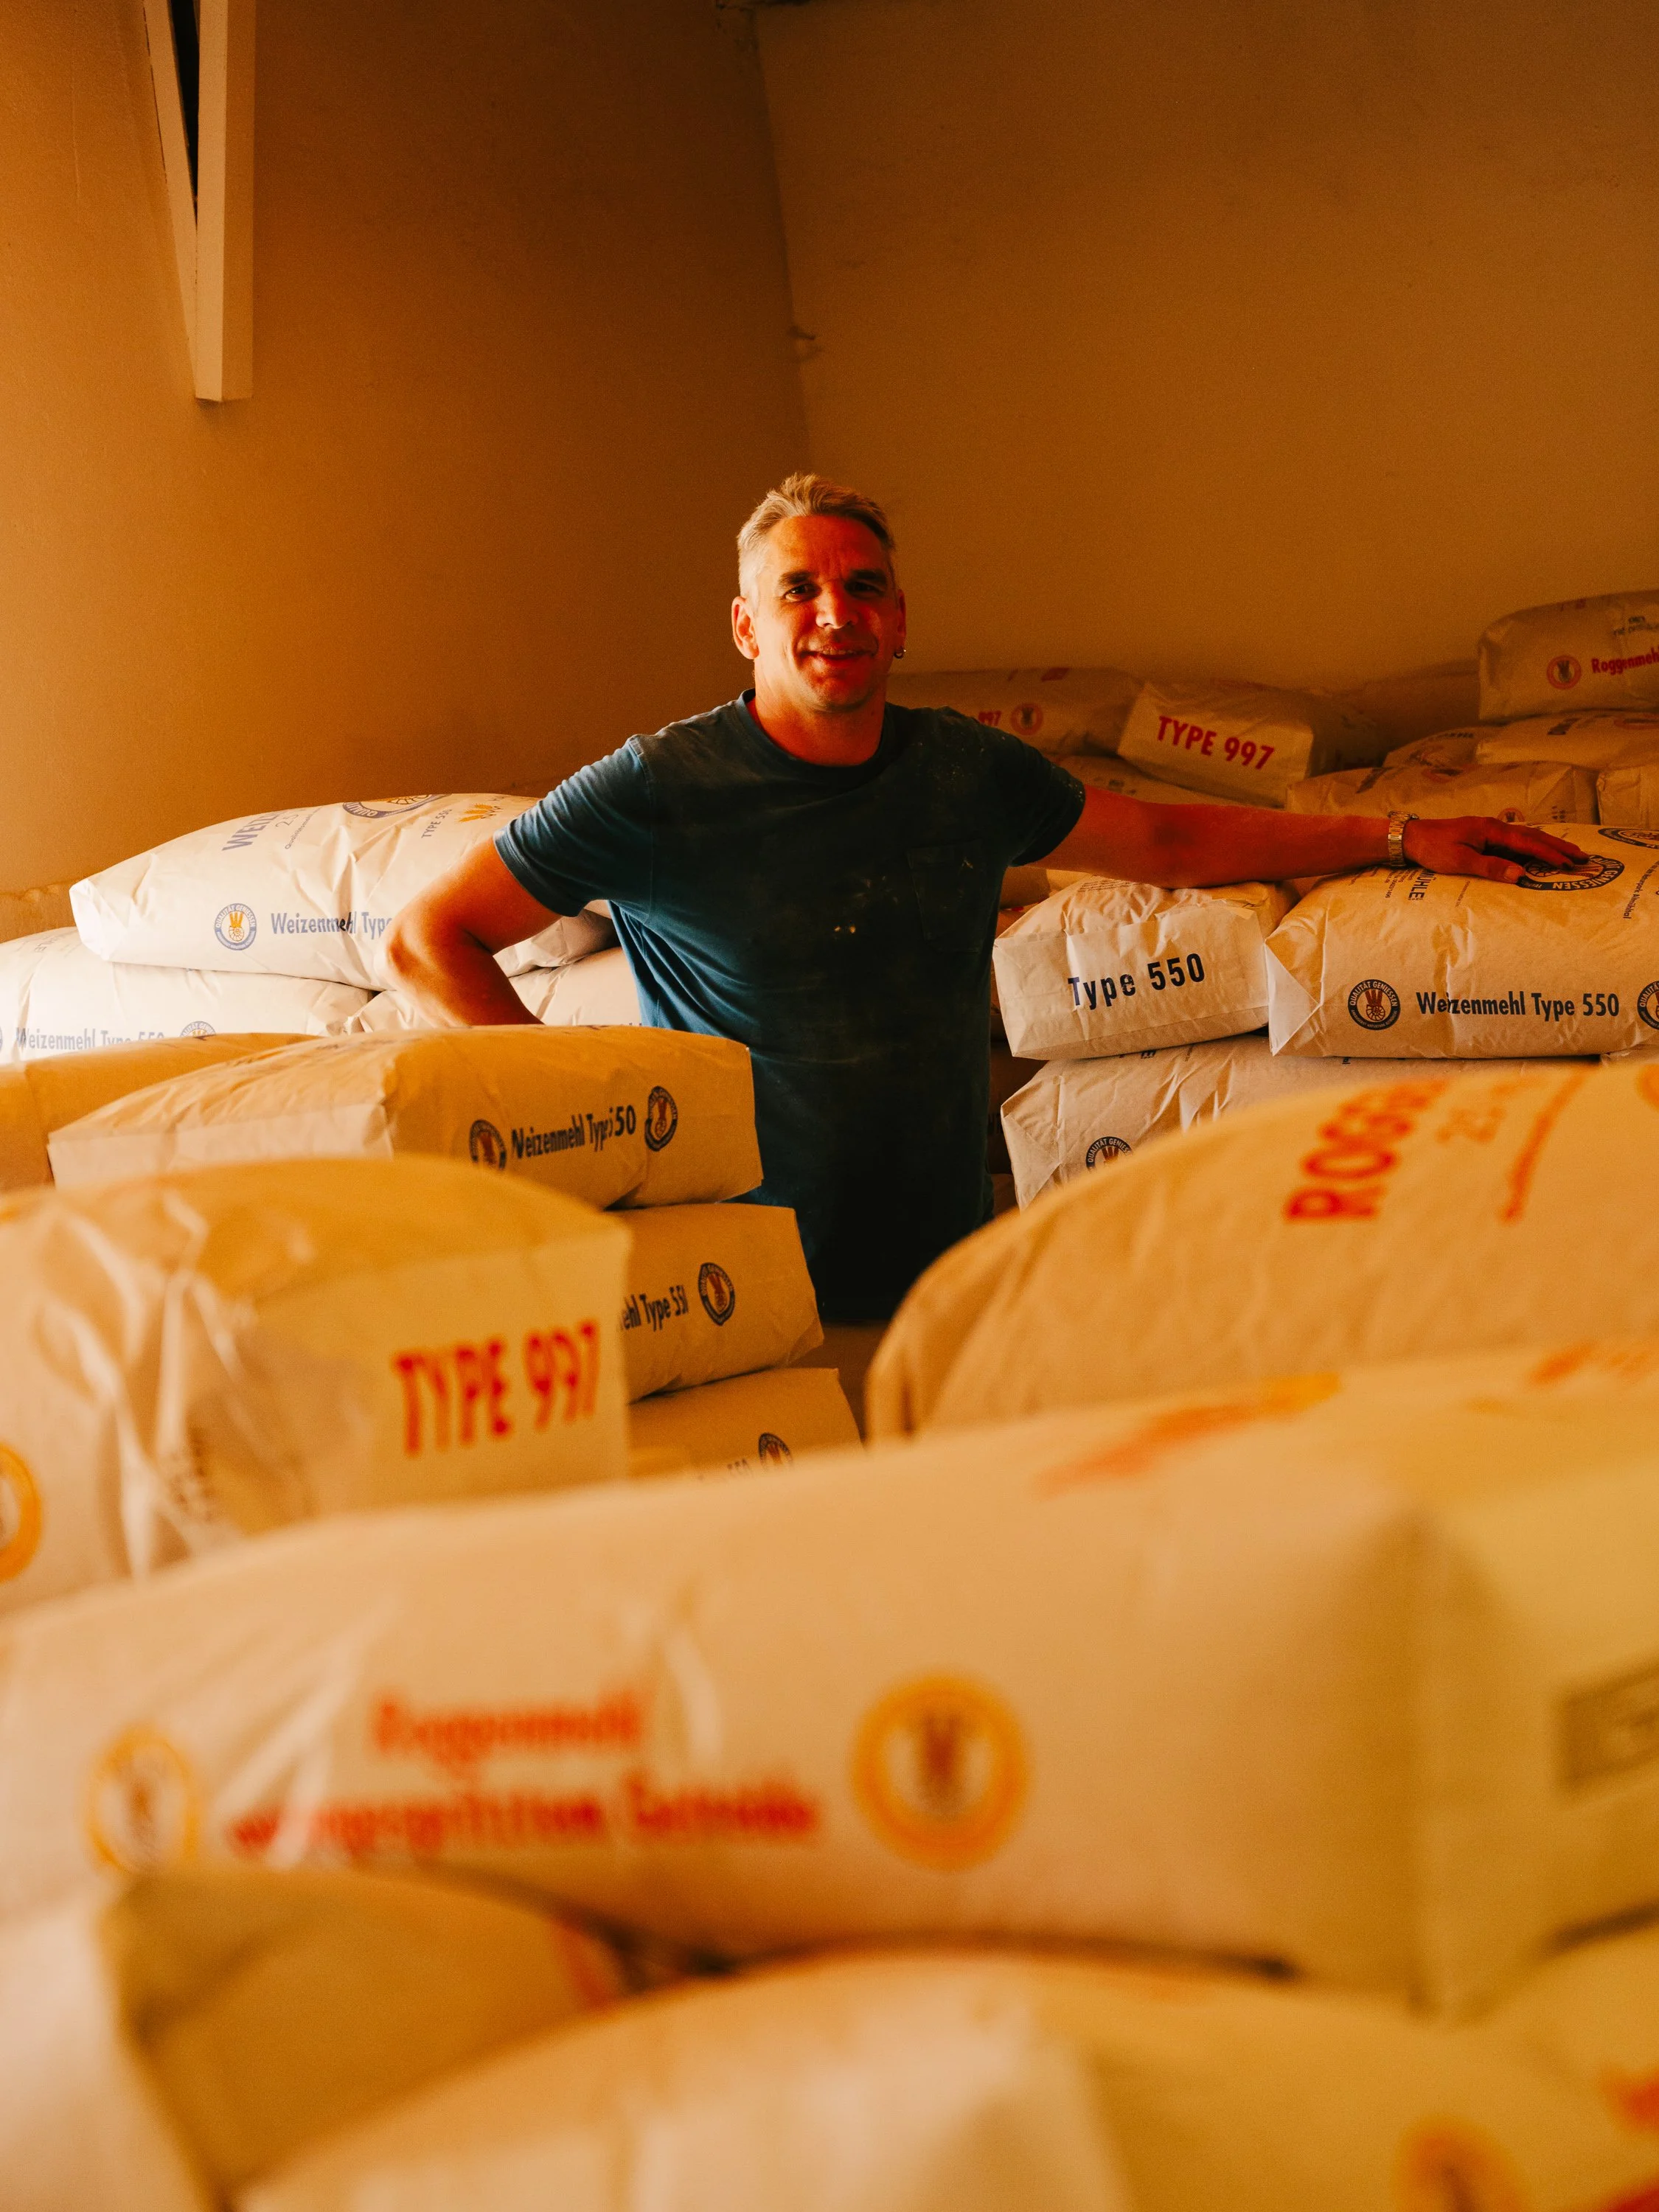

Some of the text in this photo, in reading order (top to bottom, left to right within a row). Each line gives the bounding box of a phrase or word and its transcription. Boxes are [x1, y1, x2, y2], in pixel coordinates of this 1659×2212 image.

[1158, 715, 1275, 770] TYPE 997
[421, 821, 442, 838] TYPE
[1553, 870, 1618, 890] GENIESSEN
[271, 911, 358, 934] Weizenmehl
[1068, 953, 1206, 1010] Type 550
[1349, 981, 1398, 1006] QUALITÄT GENIESSEN
[1416, 990, 1621, 1022] Weizenmehl Type 550
[1087, 1138, 1107, 1163] QUALITÄT
[639, 1293, 671, 1332] Type
[391, 1320, 600, 1458] TYPE 997
